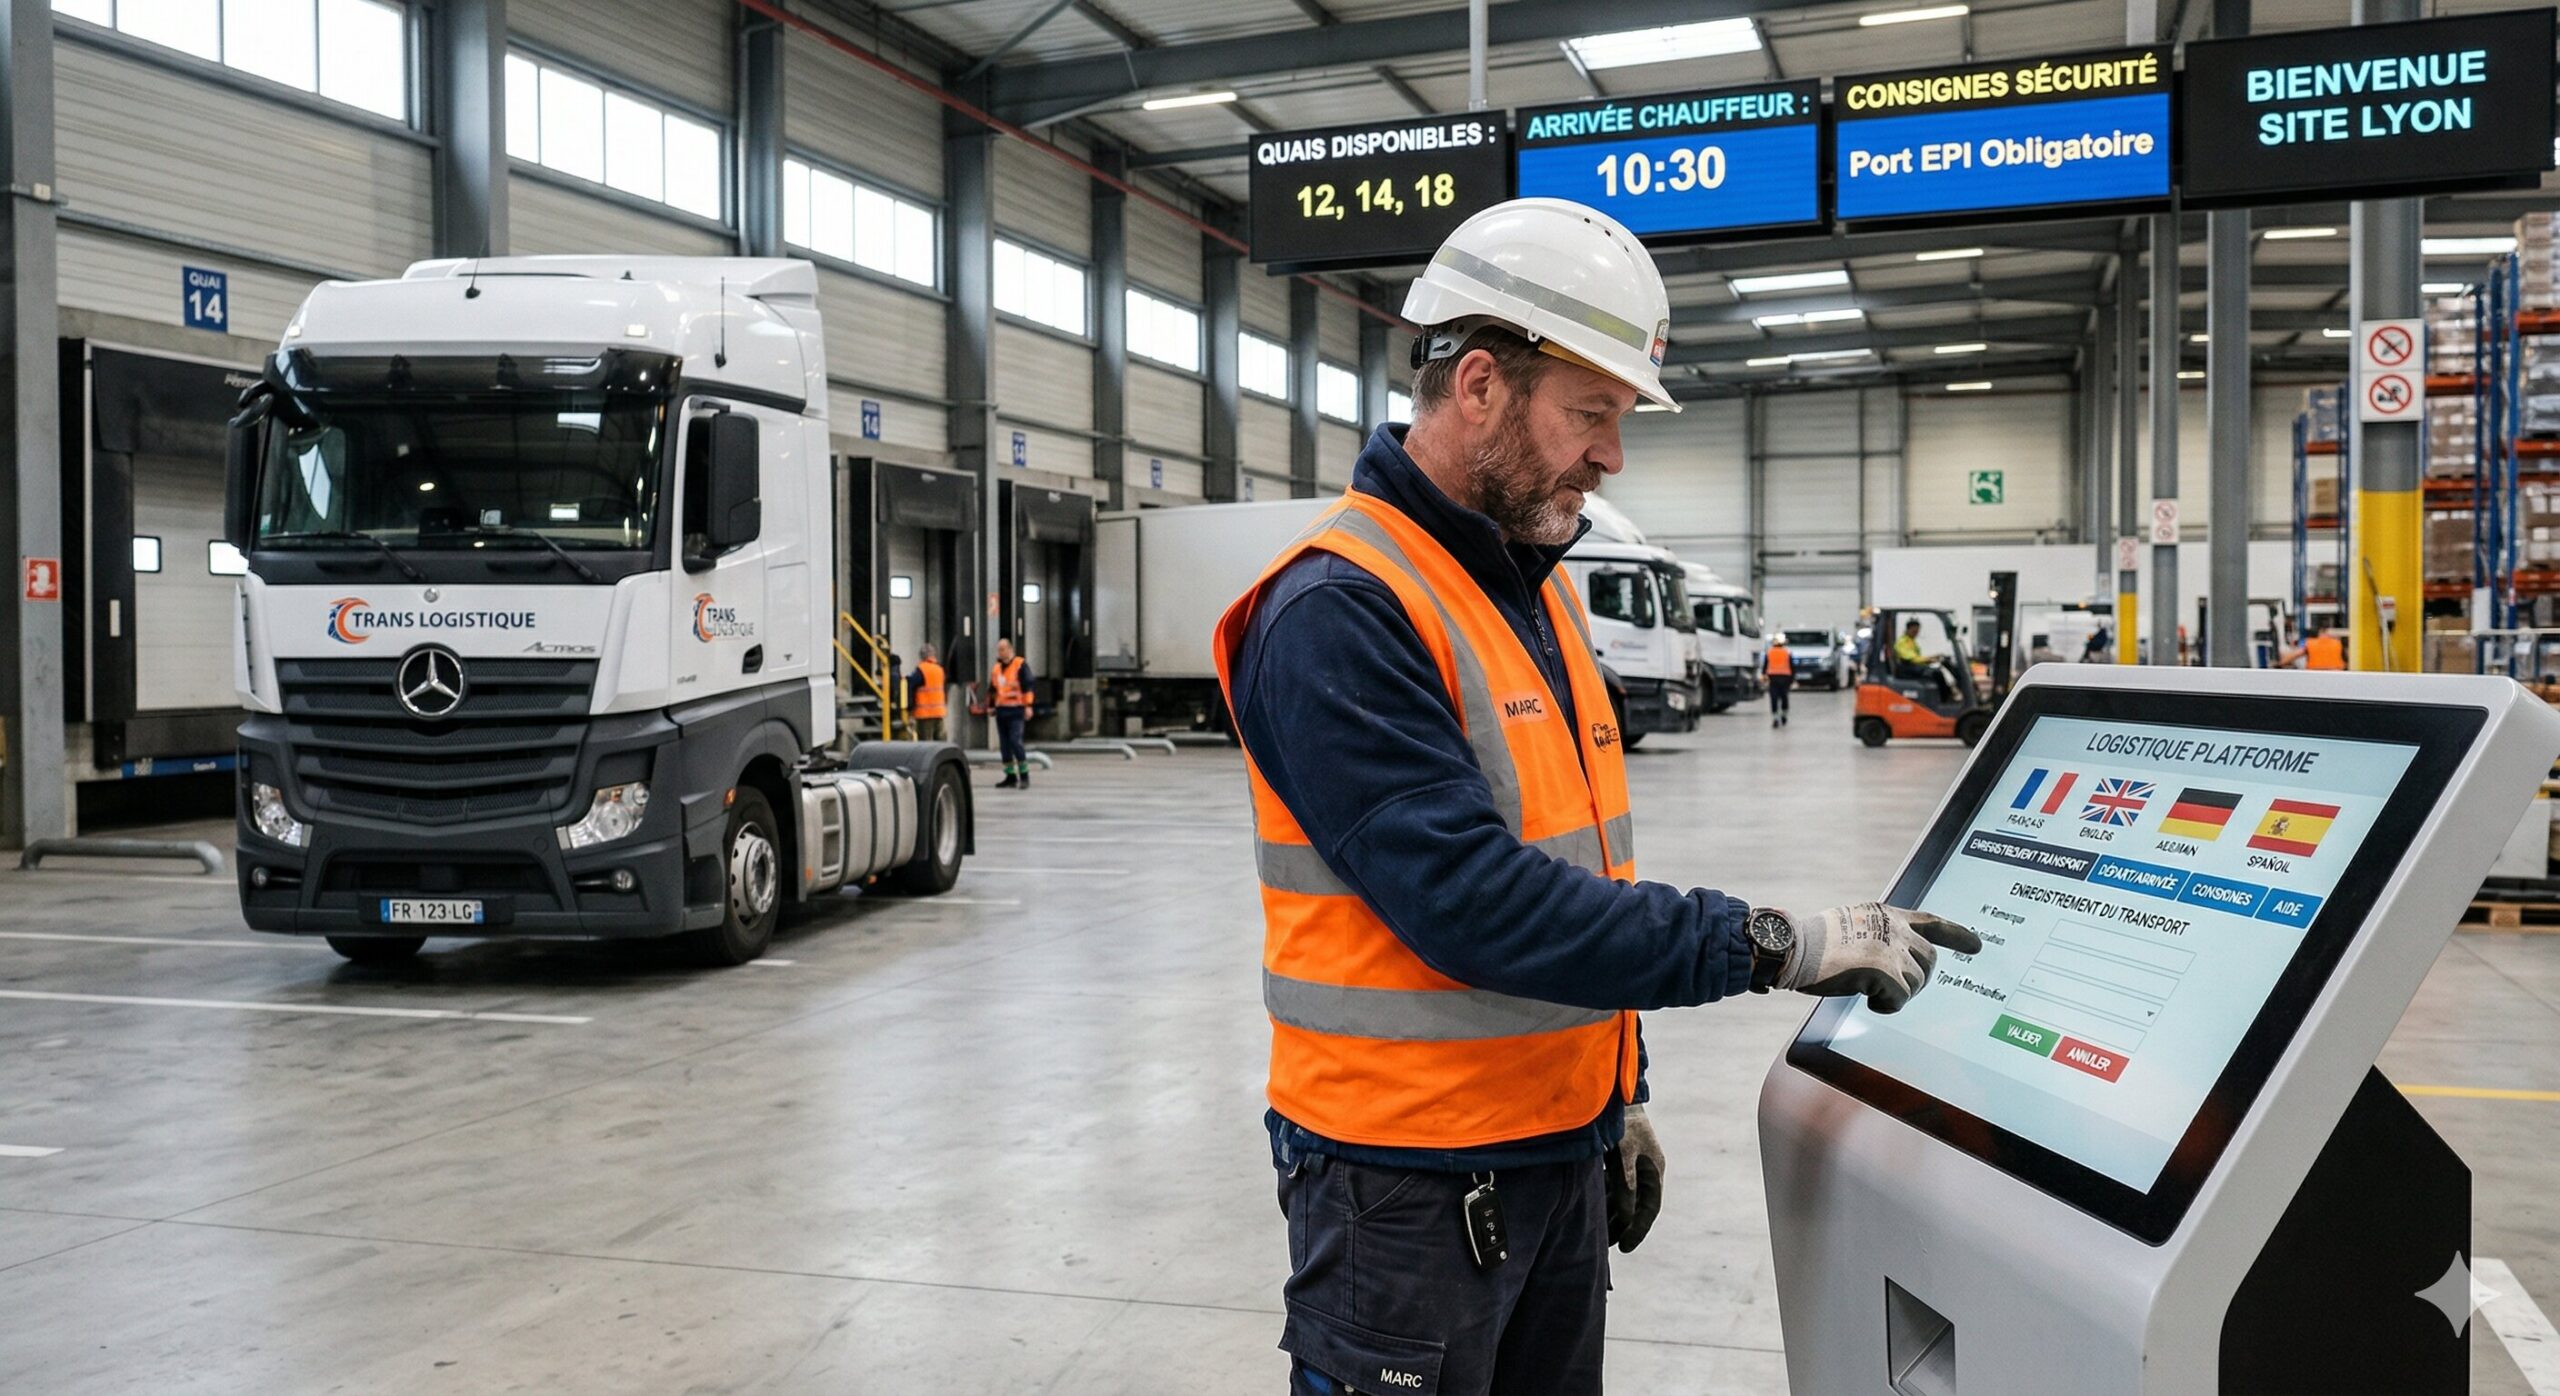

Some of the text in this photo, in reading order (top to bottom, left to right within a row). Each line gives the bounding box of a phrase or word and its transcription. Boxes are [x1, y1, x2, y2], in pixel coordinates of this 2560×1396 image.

[1847, 53, 2158, 111] CONSIGNES SÉCURITÉ
[2247, 50, 2486, 103] BIENVENUE
[1527, 105, 1633, 139] ARRIVÉE
[1639, 93, 1795, 131] CHAUFFEUR
[2259, 97, 2471, 146] SITE LYON
[1257, 136, 1326, 166] QUAIS
[1331, 123, 1482, 157] DISPONIBLES
[1849, 130, 2154, 178] Port EPI Obligatoire
[1597, 147, 1726, 197] 10:30
[1297, 173, 1455, 221] 12, 14, 18
[189, 272, 221, 289] QUAI
[189, 290, 224, 324] 14
[352, 612, 536, 629] TRANS LOGISTIQUE
[706, 608, 735, 623] TRANS
[1504, 698, 1542, 718] MARC
[2086, 732, 2319, 774] LOGISTIQUE PLATFORME
[2099, 903, 2119, 919] DU
[2117, 907, 2191, 936] TRANSPORT
[2272, 900, 2304, 917] AIDE
[1381, 1368, 1422, 1388] MARC
